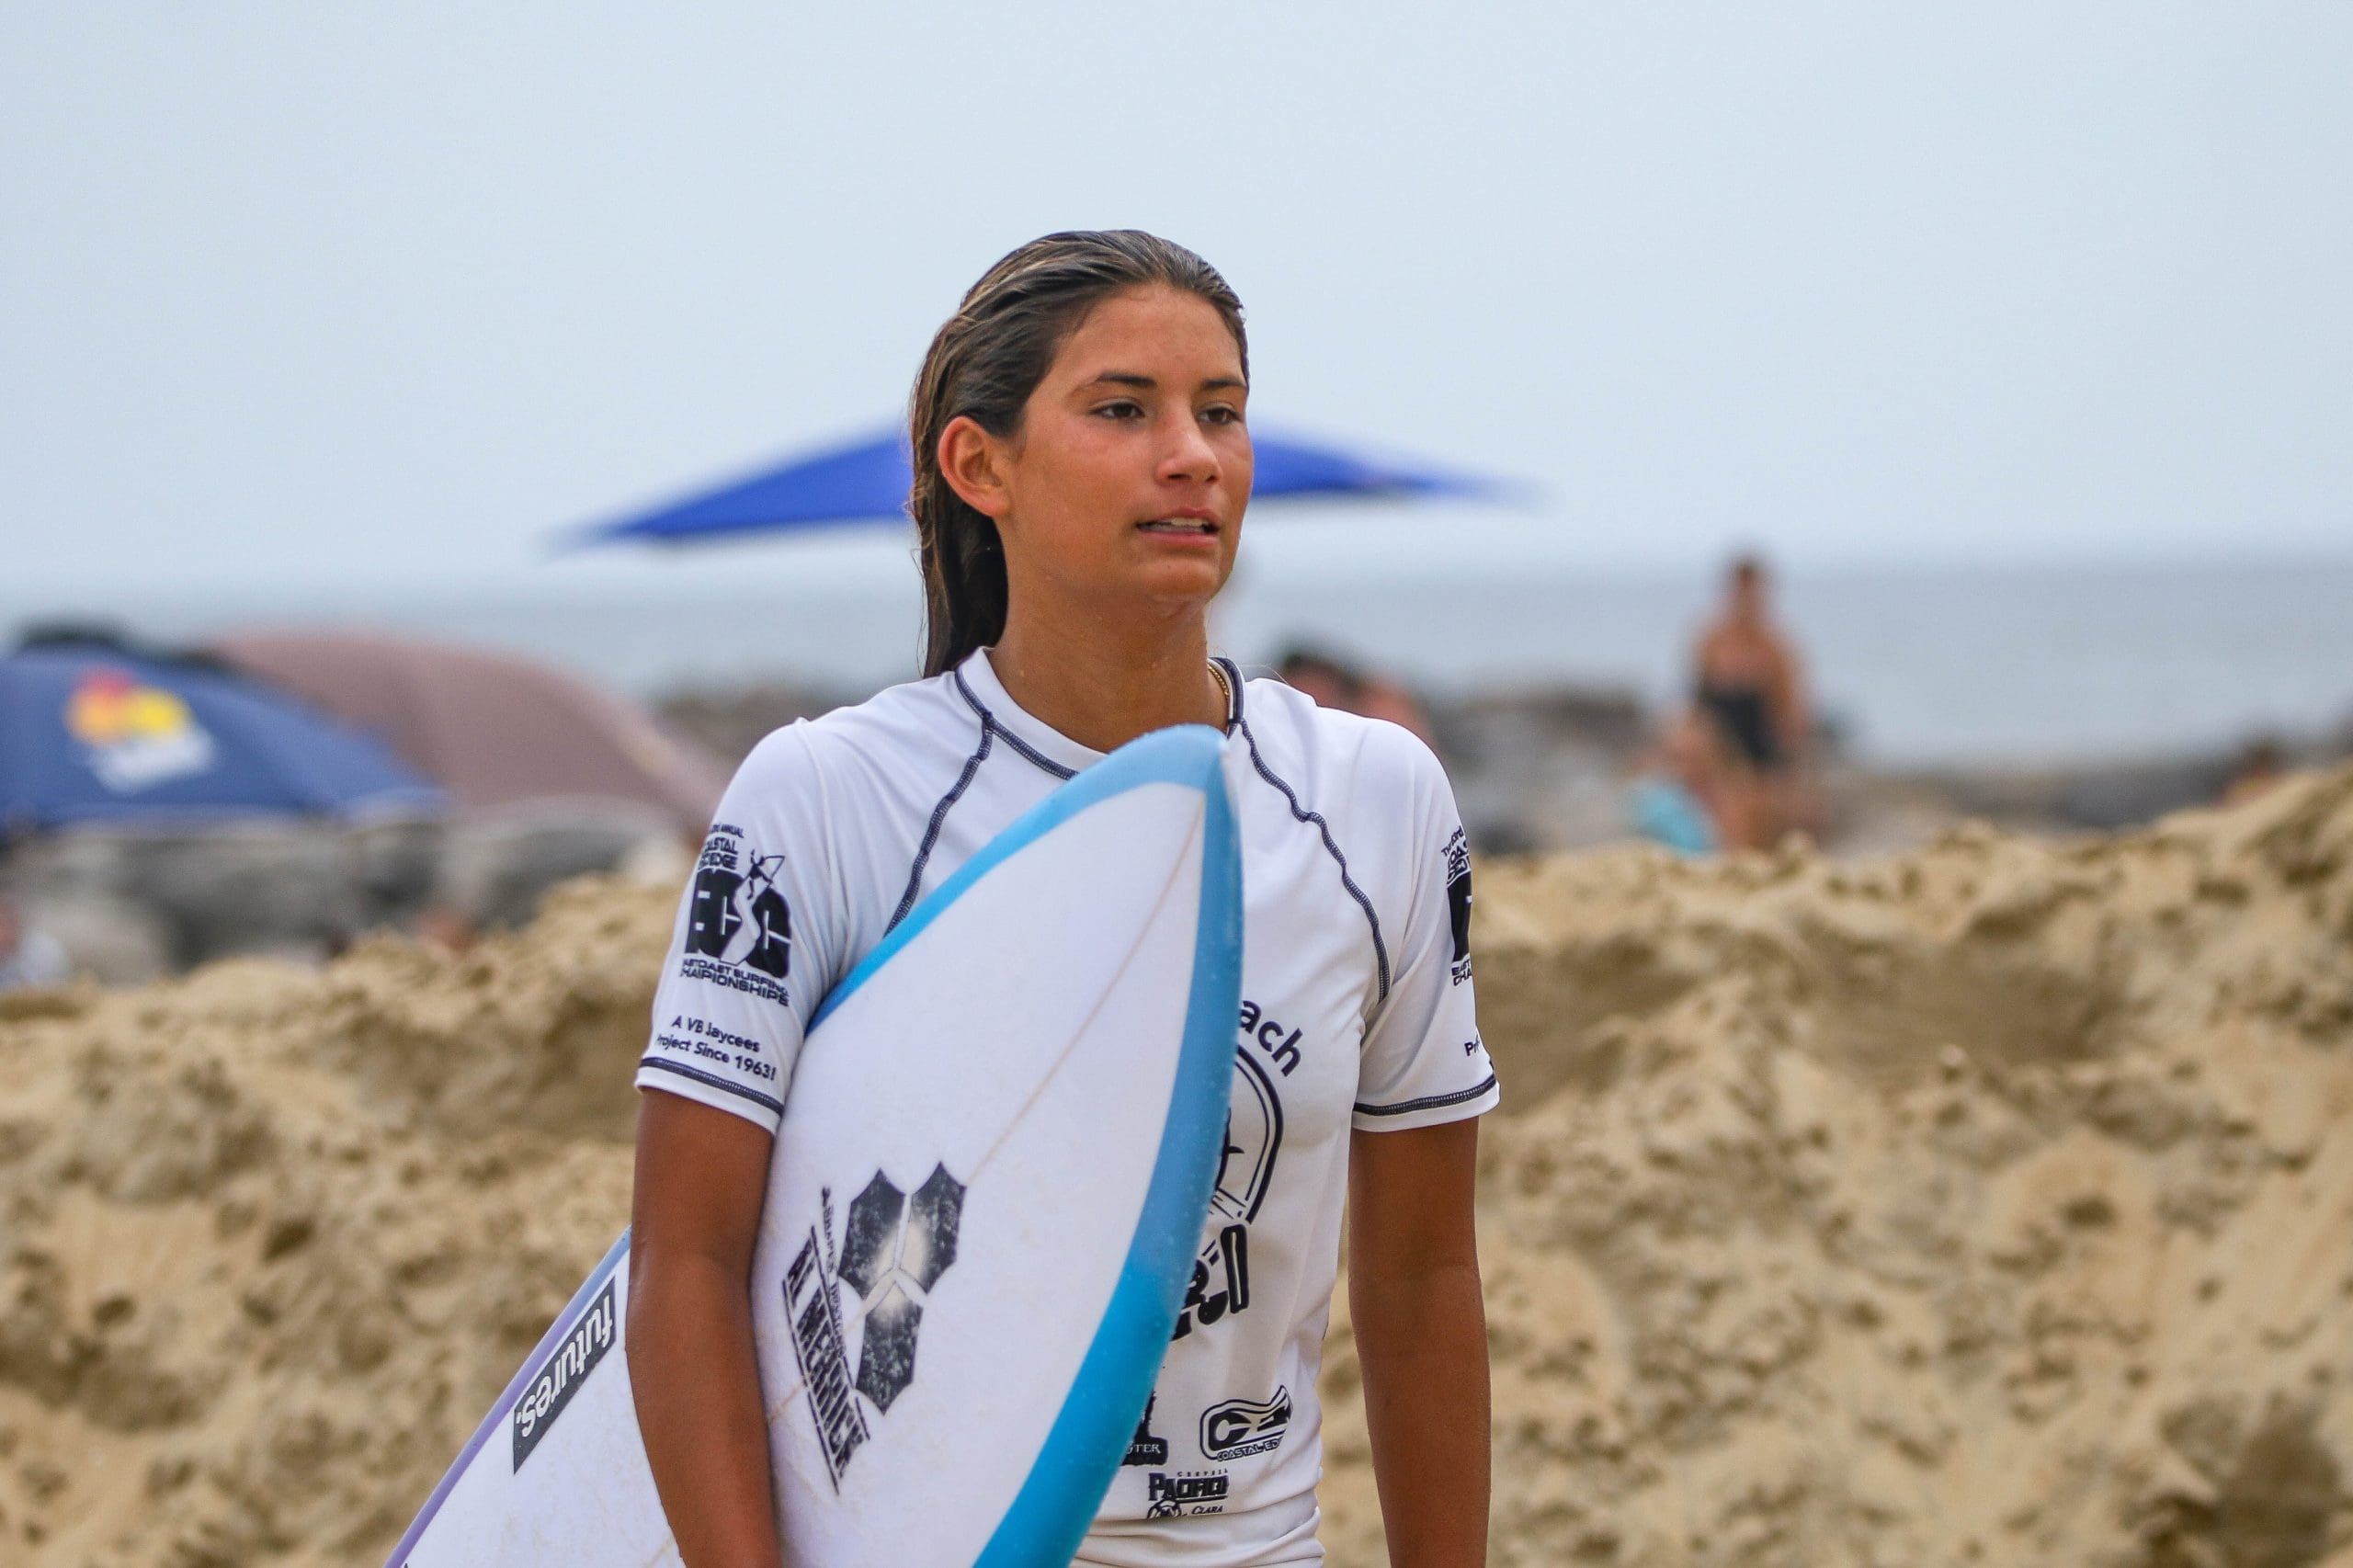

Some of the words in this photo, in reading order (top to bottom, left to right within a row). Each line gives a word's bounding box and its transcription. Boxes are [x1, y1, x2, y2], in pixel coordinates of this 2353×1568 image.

[671, 1015, 682, 1028] A
[688, 1017, 704, 1033] VB
[706, 1022, 760, 1052] Jaycees
[1240, 1000, 1303, 1077] ach
[694, 1041, 730, 1063] Since
[735, 1055, 777, 1081] 1963!
[1216, 1442, 1263, 1461] COASTAL
[1264, 1436, 1283, 1451] ED
